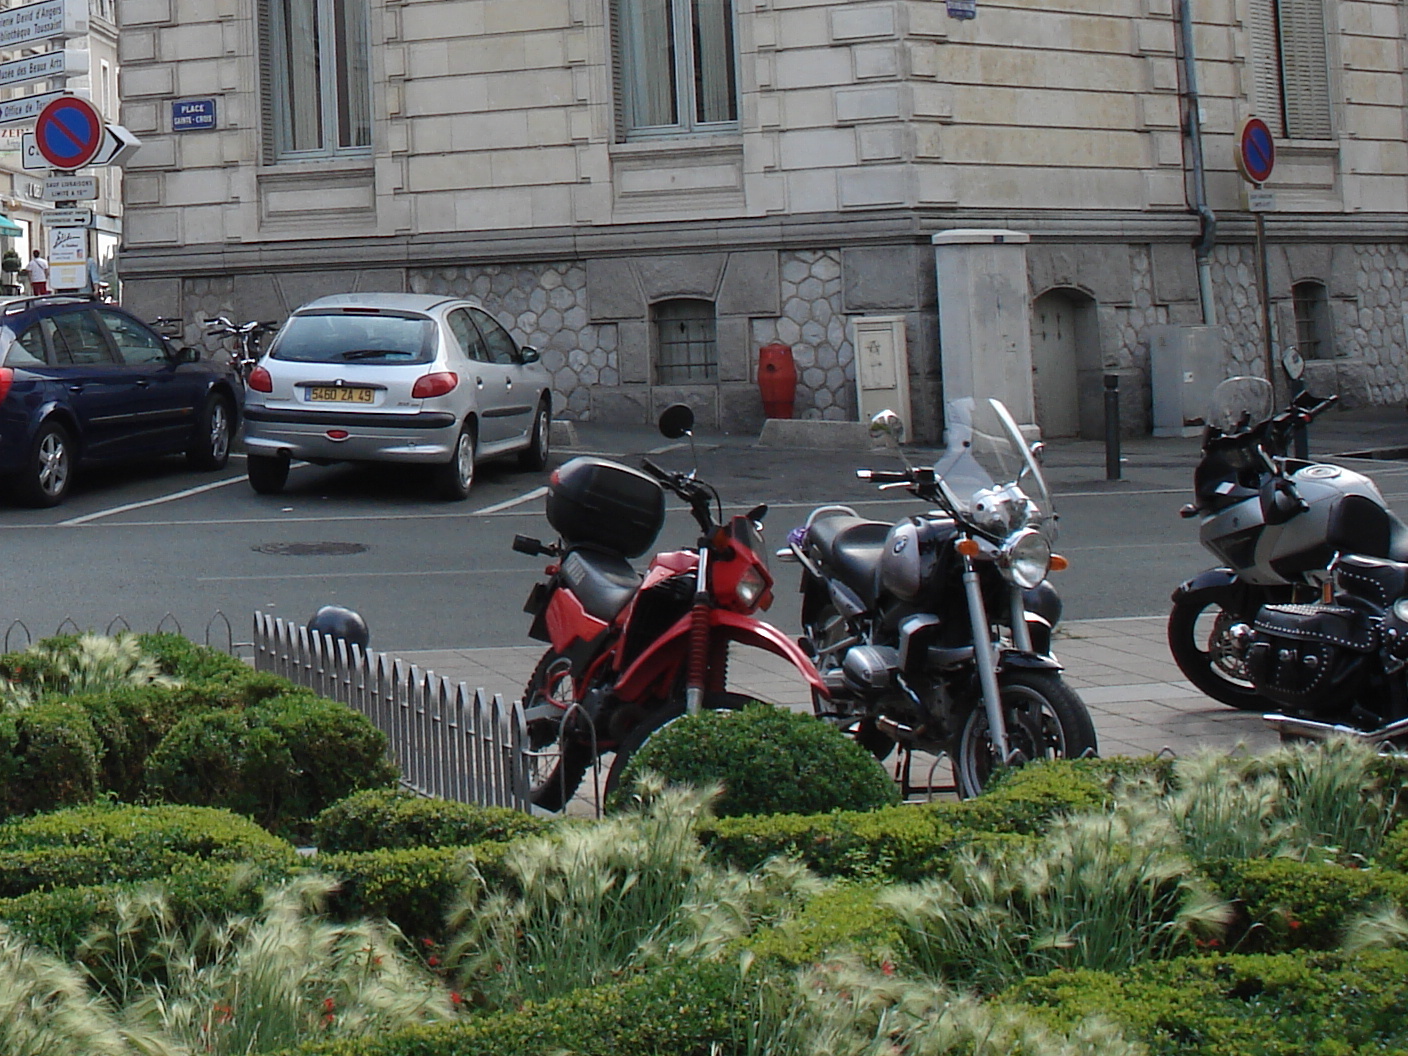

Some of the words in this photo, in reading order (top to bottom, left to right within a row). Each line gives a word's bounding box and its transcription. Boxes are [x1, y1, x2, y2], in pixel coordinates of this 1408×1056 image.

[16, 11, 33, 24] David
[35, 6, 61, 20] d'Angers
[34, 19, 61, 34] Toussaint
[17, 65, 27, 76] des
[29, 62, 46, 74] Beaux
[50, 58, 62, 69] Arts
[4, 105, 22, 117] Office
[25, 102, 32, 113] de
[181, 104, 205, 114] PLACE
[312, 388, 337, 401] 5460
[341, 388, 354, 401] ZA
[358, 389, 371, 402] 49
